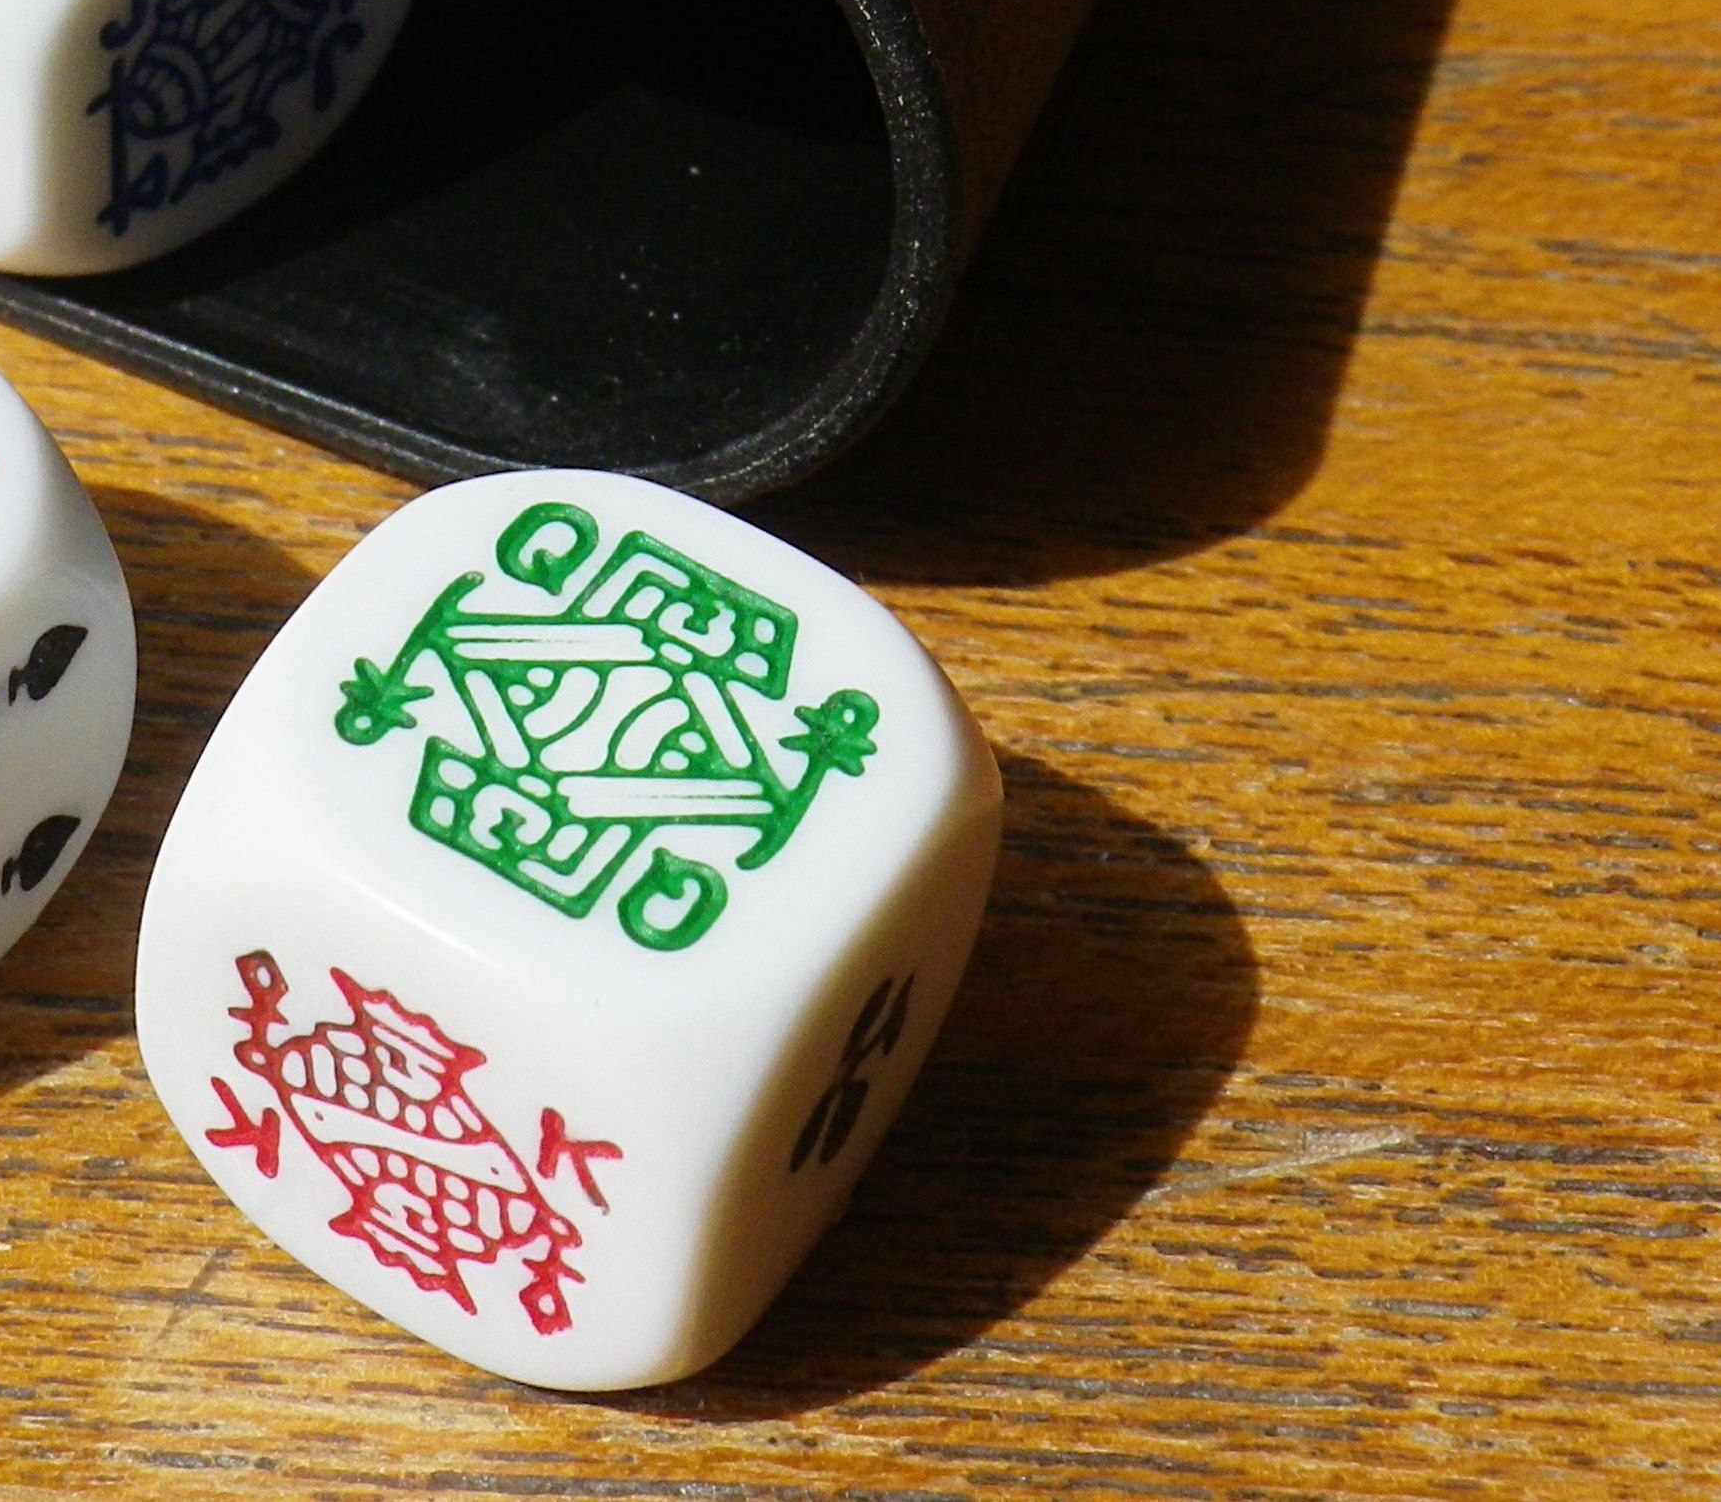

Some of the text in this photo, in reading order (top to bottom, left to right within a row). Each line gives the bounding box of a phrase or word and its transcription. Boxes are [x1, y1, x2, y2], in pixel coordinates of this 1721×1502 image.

[496, 501, 599, 596] Q
[617, 847, 728, 951] Q
[205, 1077, 281, 1179] K
[536, 1107, 623, 1215] K
